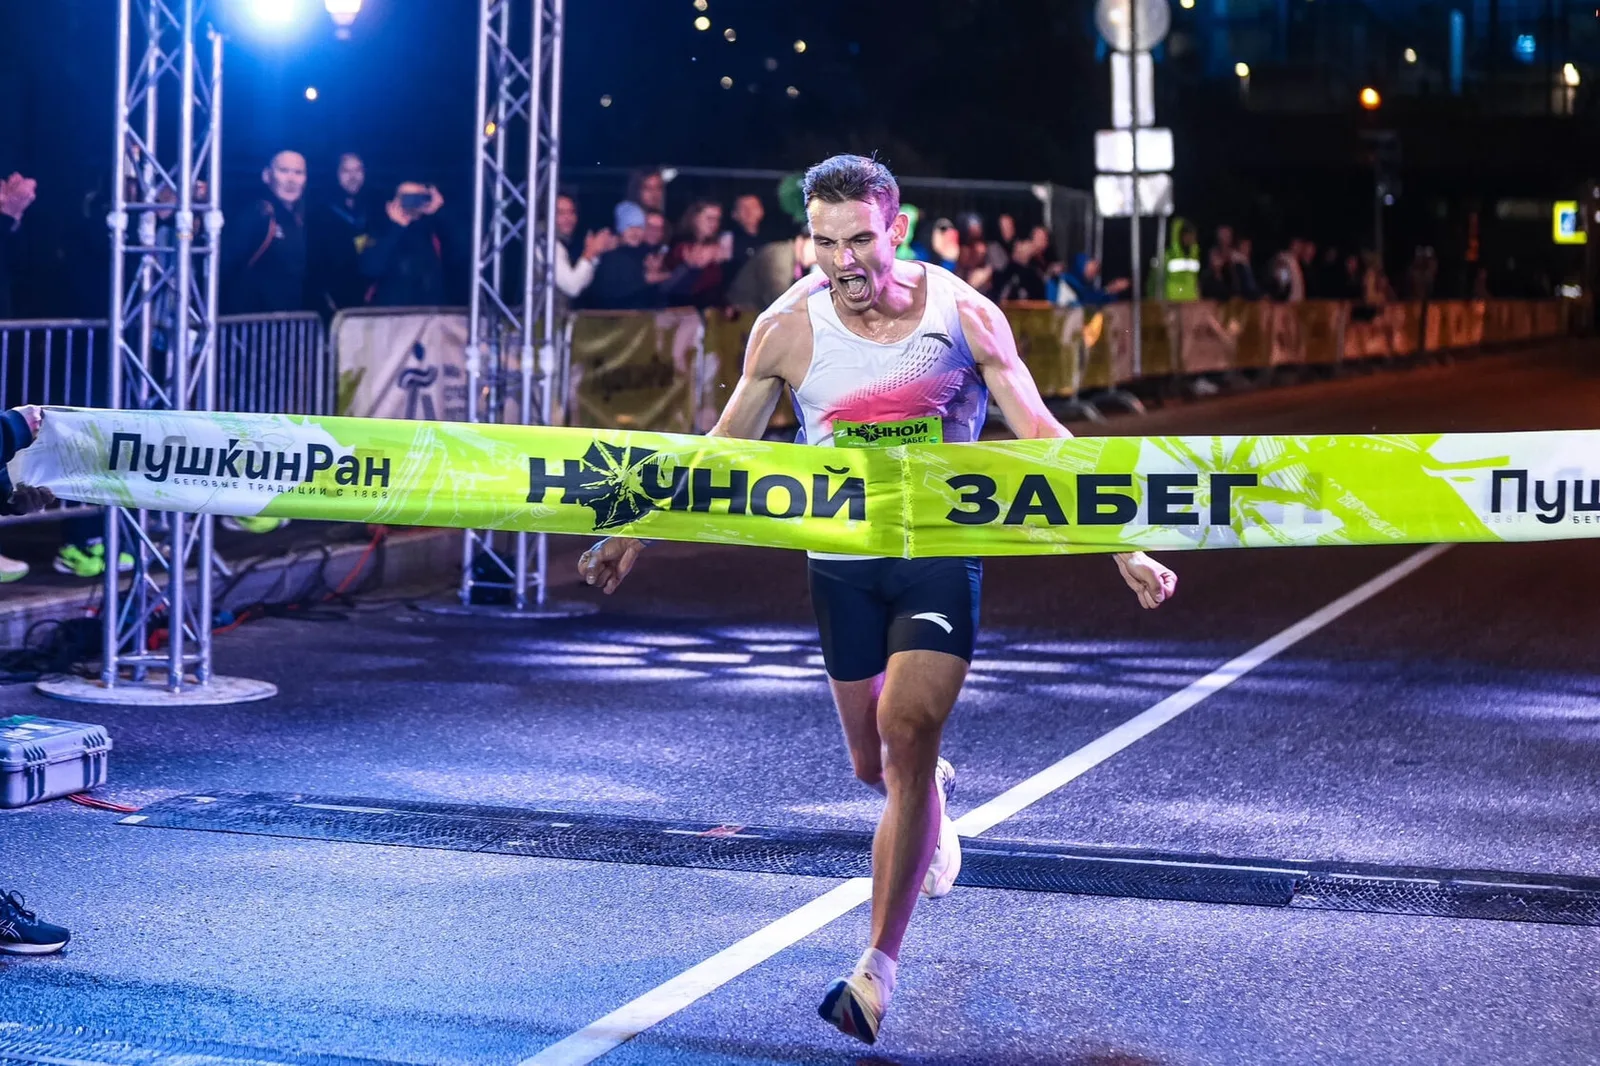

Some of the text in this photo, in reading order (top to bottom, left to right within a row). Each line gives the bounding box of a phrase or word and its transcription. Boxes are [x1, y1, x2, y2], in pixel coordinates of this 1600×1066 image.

[173, 477, 389, 499] БЕГОВЫЕ ТРАДИЦИИ С 1888
[945, 473, 1258, 526] ЗАБЕГ
